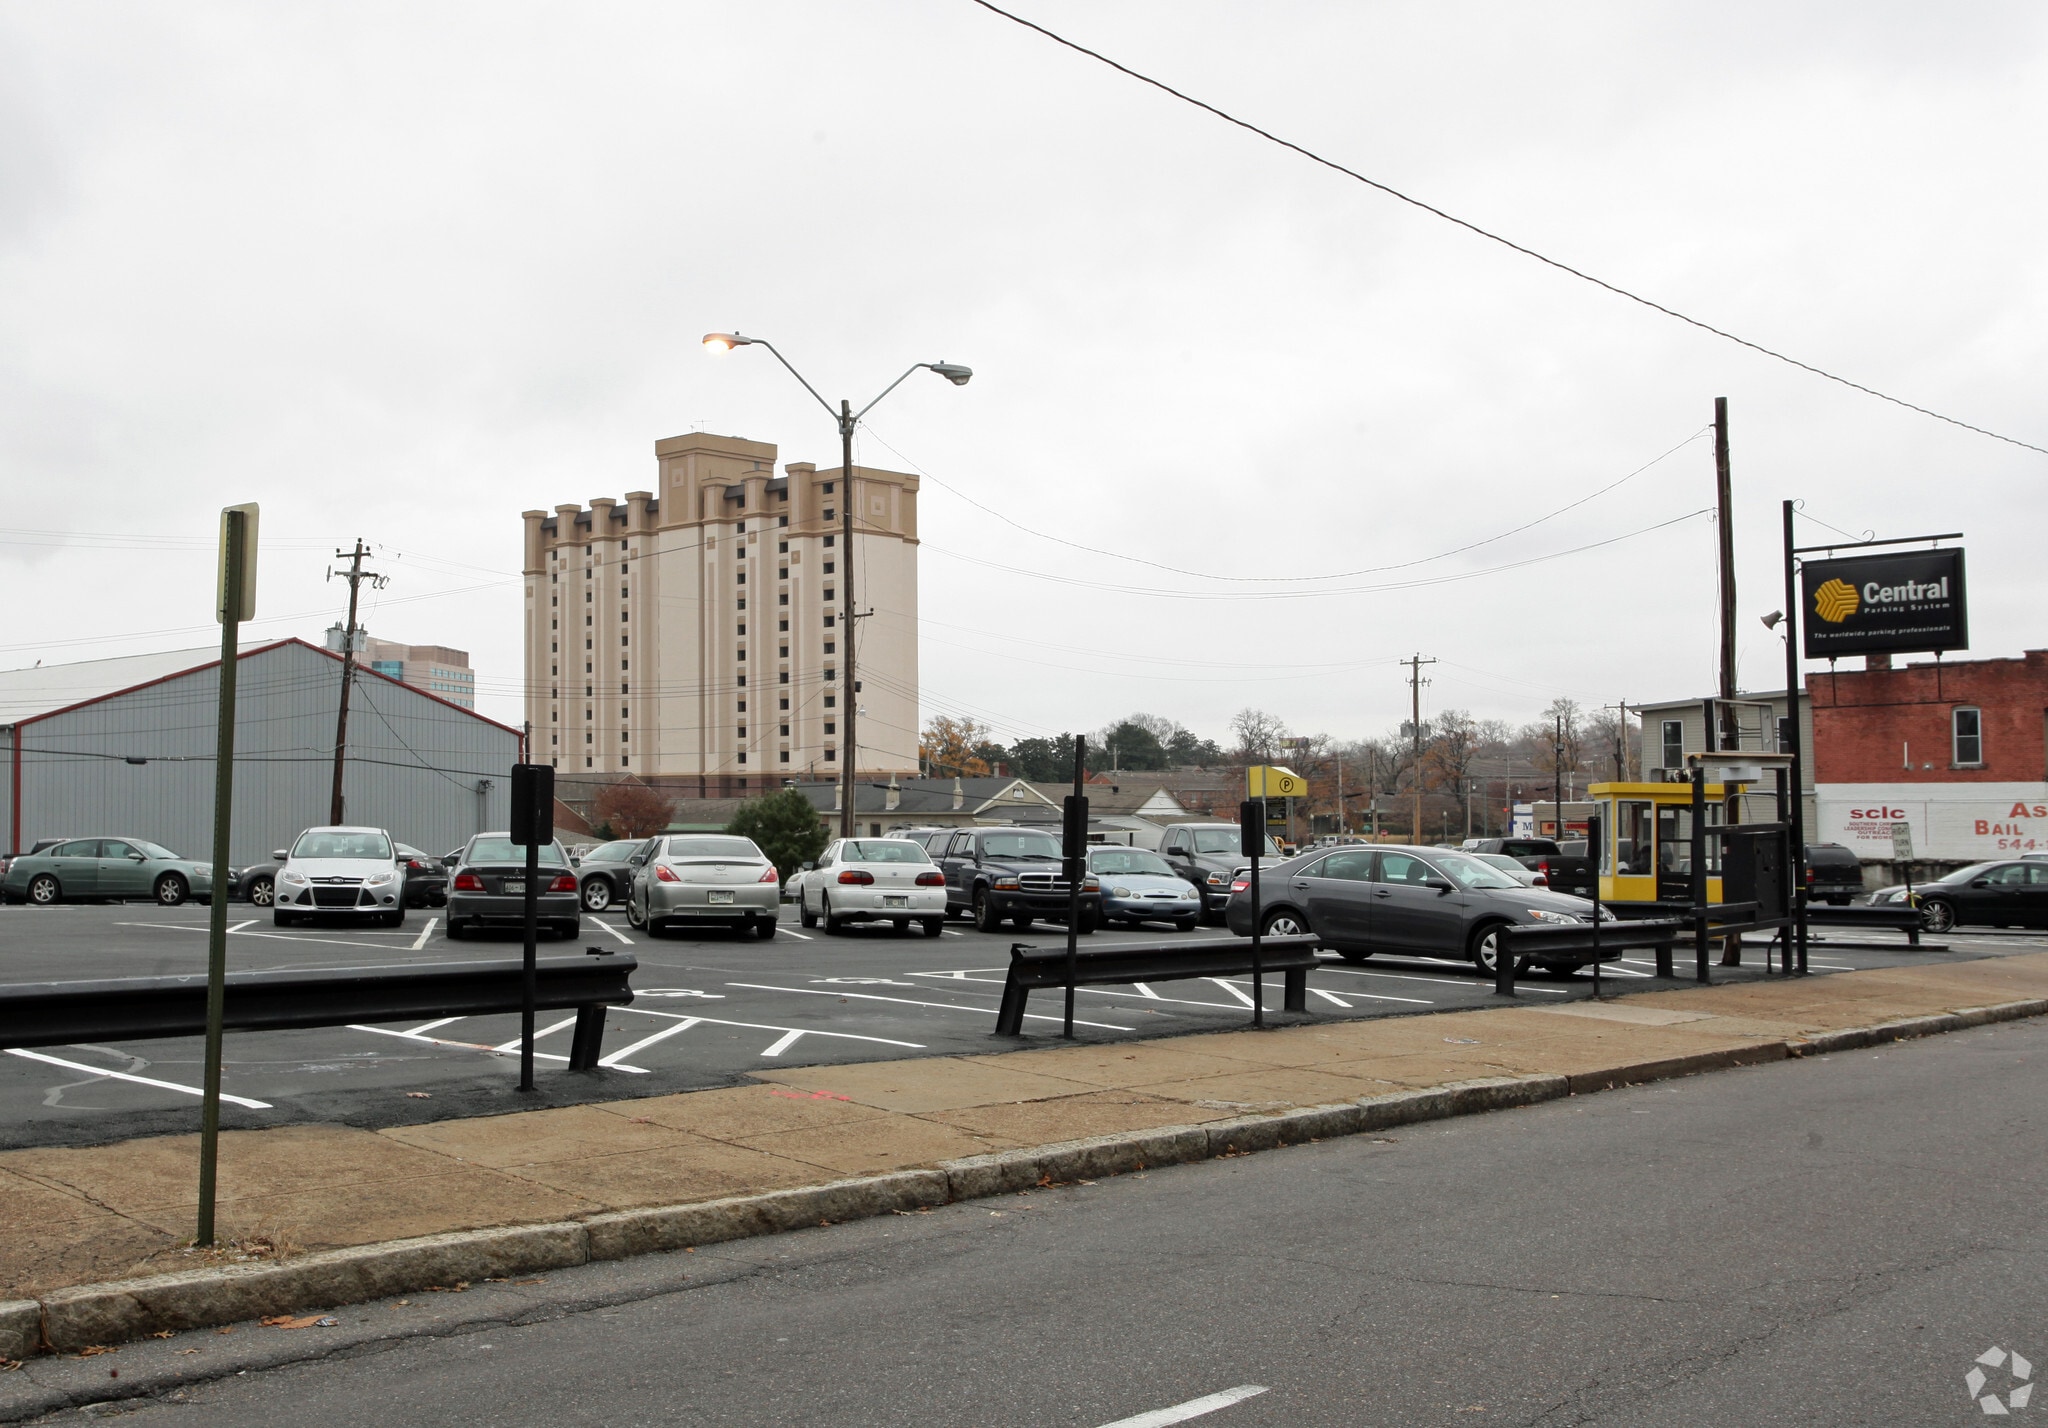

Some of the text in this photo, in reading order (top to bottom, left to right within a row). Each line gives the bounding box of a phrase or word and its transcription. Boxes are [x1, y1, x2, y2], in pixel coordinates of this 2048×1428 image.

[1863, 576, 1949, 604] Central
[1864, 602, 1950, 614] Parking System
[1868, 628, 1896, 637] parking
[1898, 625, 1951, 635] professionals
